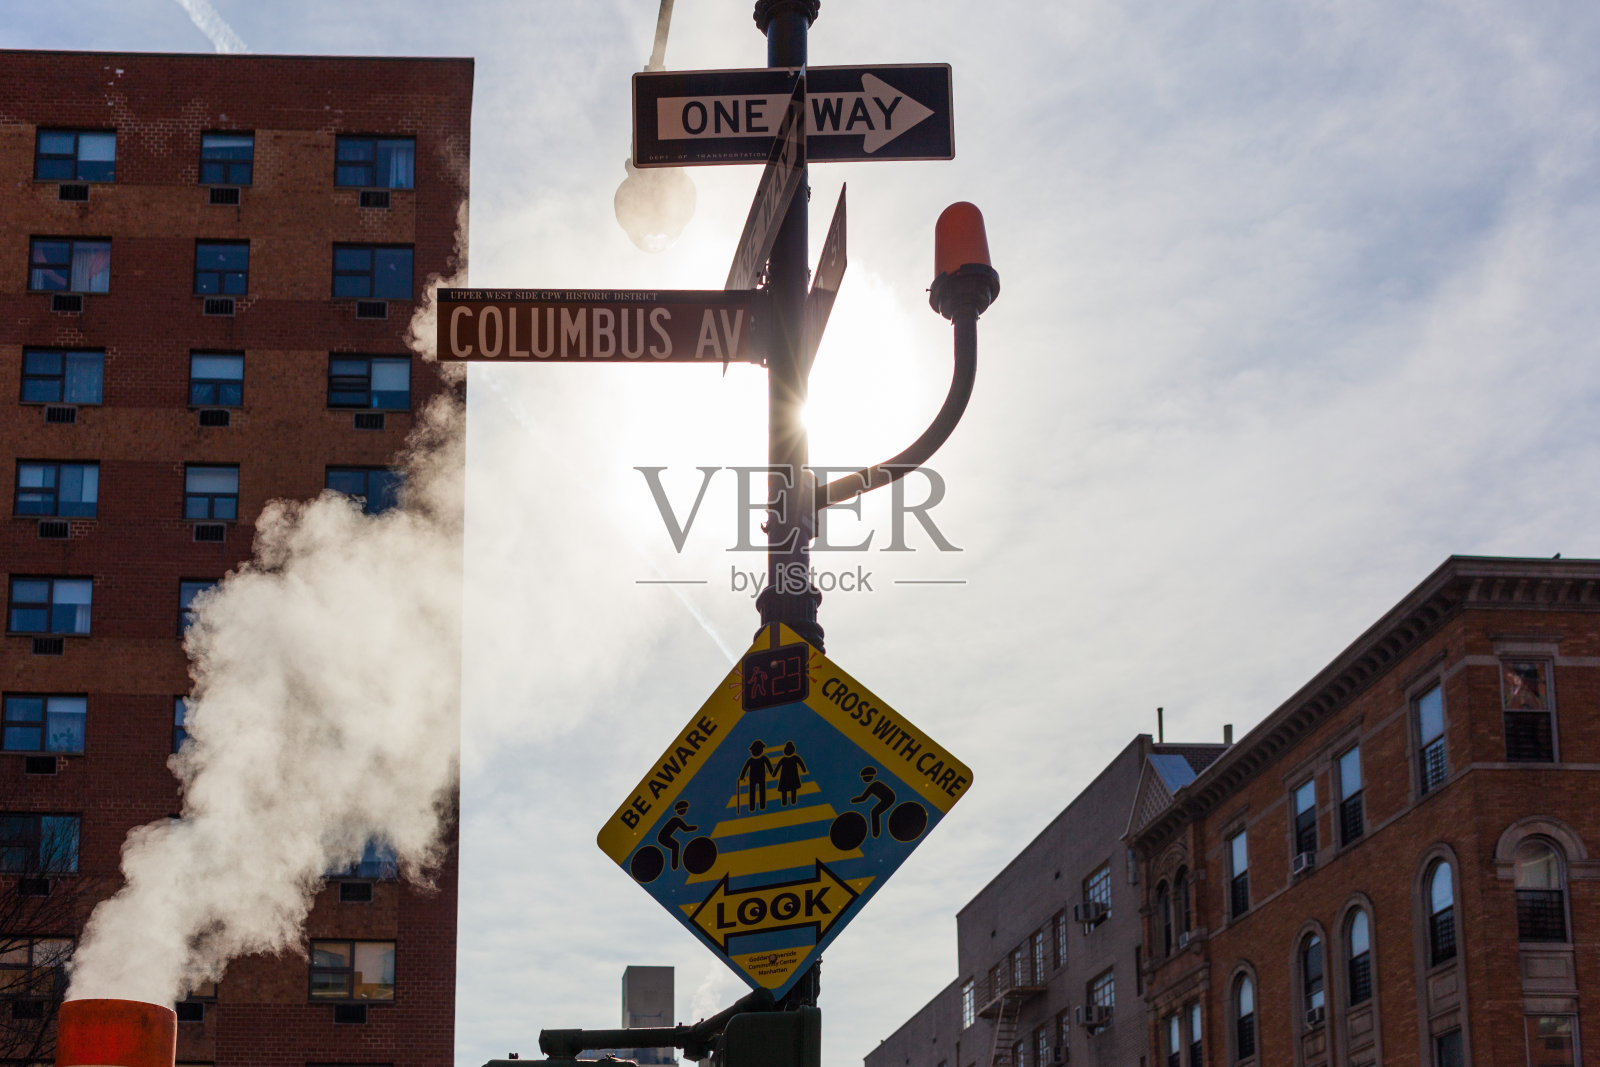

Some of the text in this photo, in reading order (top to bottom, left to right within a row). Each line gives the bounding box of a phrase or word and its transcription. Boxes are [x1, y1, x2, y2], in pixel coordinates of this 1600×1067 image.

[681, 96, 903, 135] ONE WAY
[450, 291, 659, 301] UPPER WEST SIDE CPW HISTORIC DISTRICT
[450, 305, 673, 360] COLUMBUS
[695, 308, 744, 360] AV
[821, 677, 968, 798] CROSS WITH CARE
[620, 715, 718, 830] BE AWARE
[716, 886, 833, 929] LOOK
[748, 955, 771, 963] Goddar
[758, 967, 788, 976] Manhattan
[779, 958, 798, 966] Center
